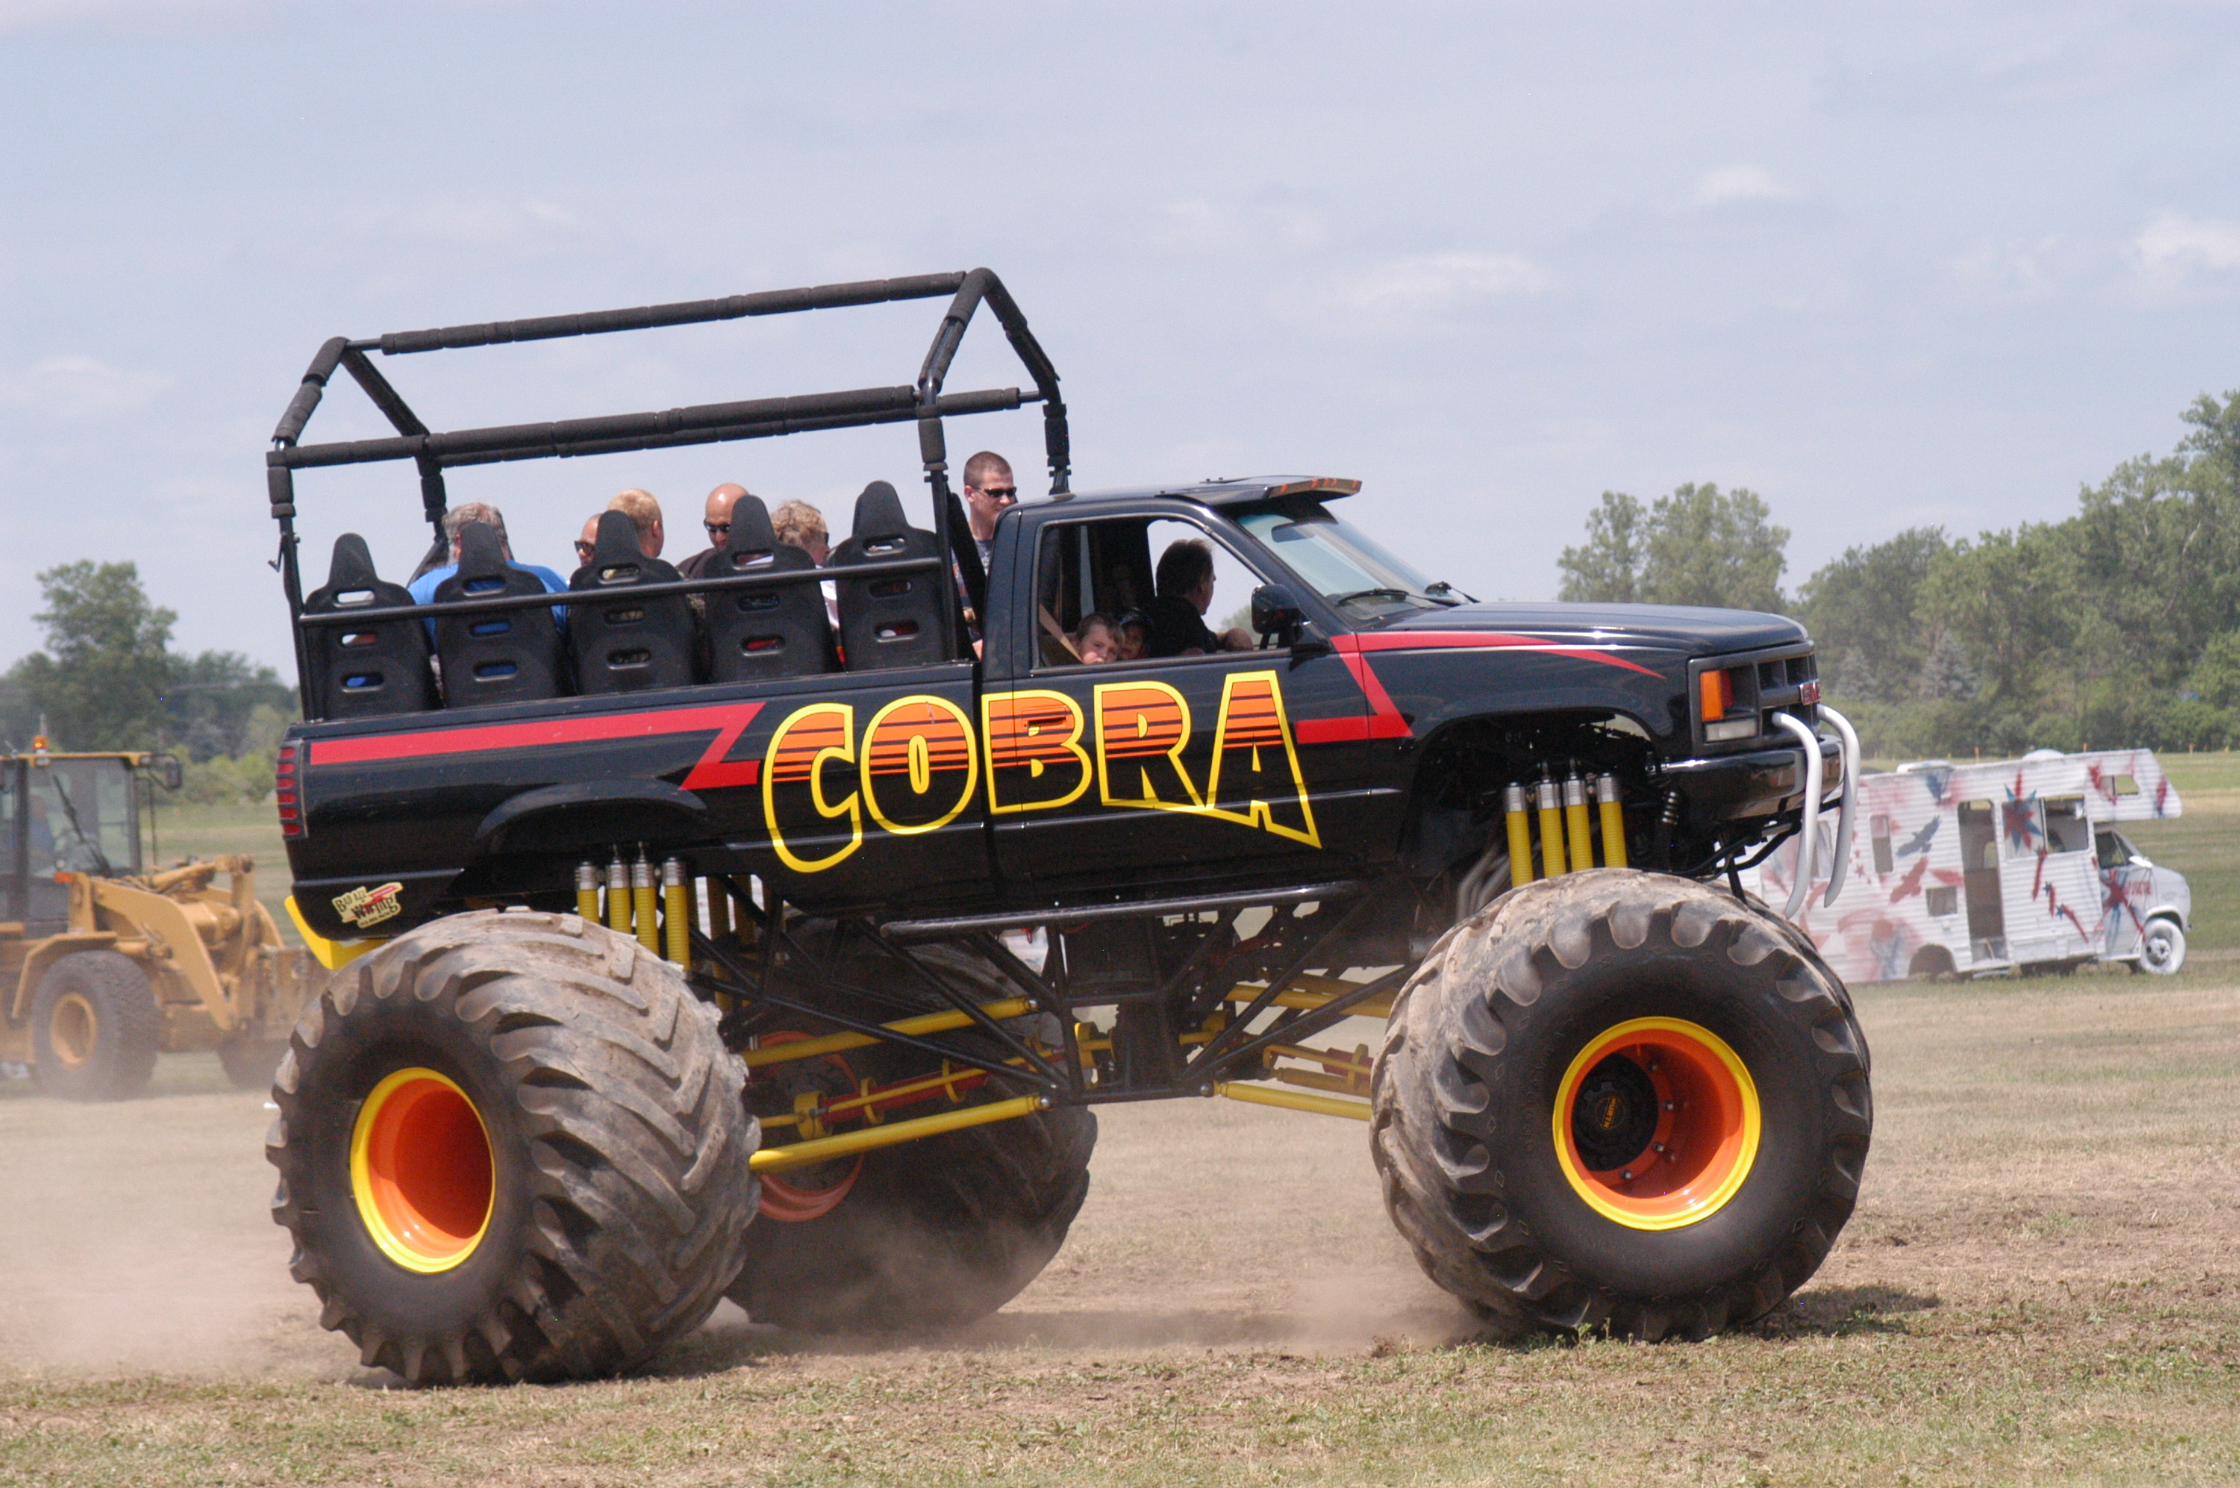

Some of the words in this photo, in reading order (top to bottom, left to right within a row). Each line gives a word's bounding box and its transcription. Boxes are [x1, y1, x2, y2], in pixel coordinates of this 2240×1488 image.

[762, 670, 1322, 873] COBRA
[335, 893, 353, 912] BAD
[351, 894, 398, 920] Wiring
